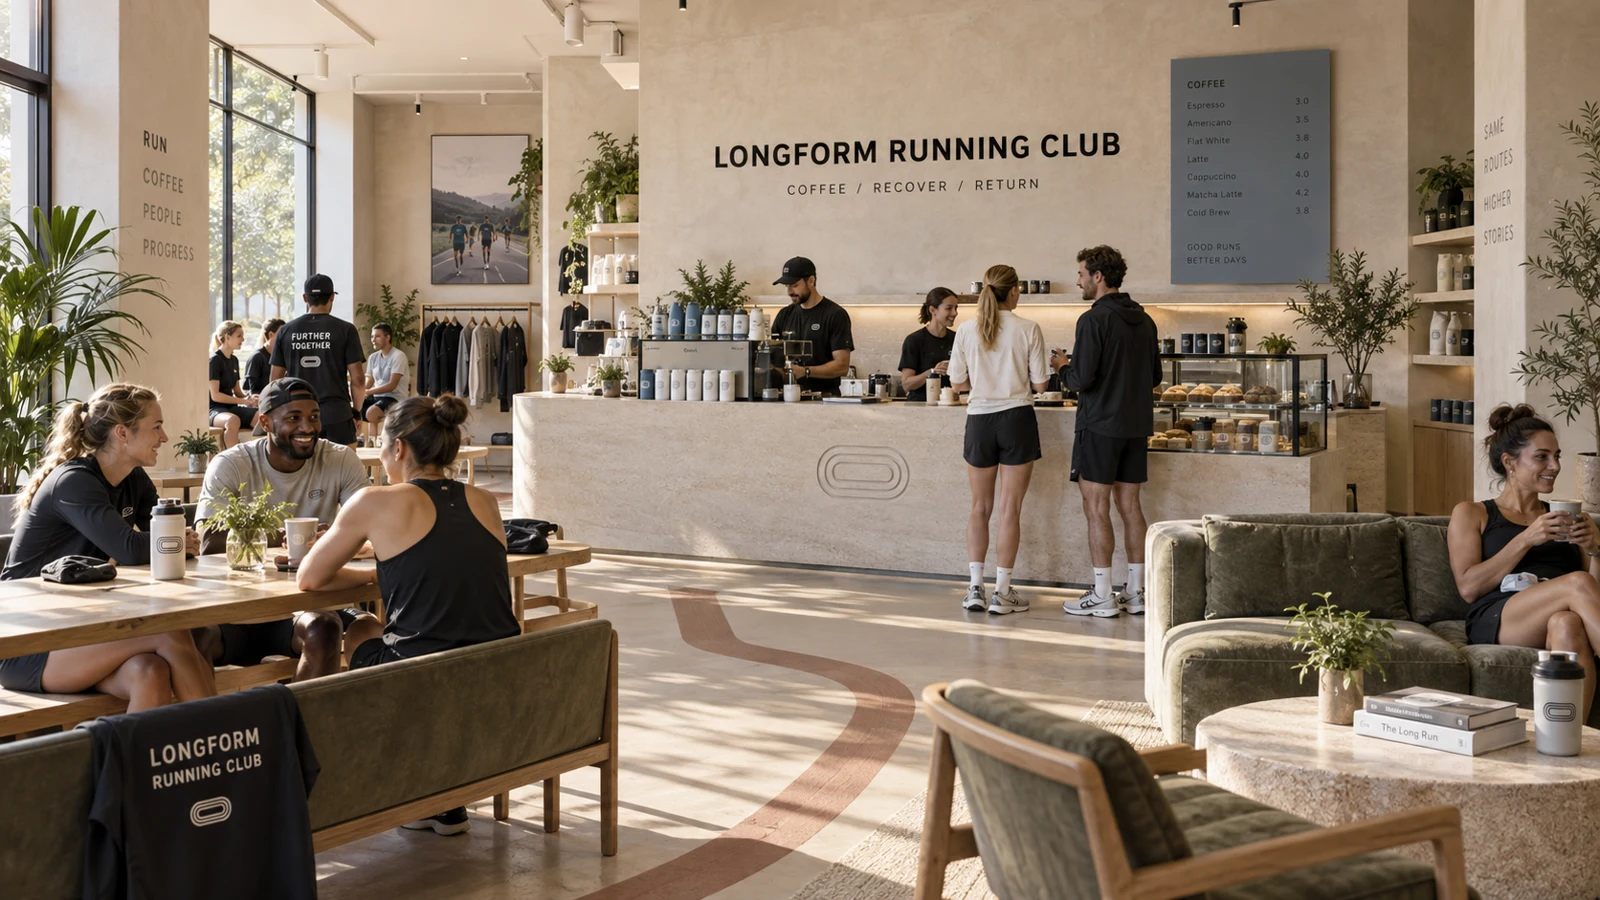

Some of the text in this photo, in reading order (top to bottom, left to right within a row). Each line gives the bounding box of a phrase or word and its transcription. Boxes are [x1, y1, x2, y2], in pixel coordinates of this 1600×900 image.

[1187, 79, 1226, 89] COFFEE
[1187, 97, 1310, 111] Espresso 3.0
[1187, 115, 1310, 128] Americano 3.5
[1484, 116, 1504, 140] SAME
[143, 130, 168, 154] RUN
[1187, 133, 1310, 145] Flat White 3.8
[714, 132, 1121, 168] LONGFORM RUNNING CLUB
[1187, 151, 1310, 164] Latte 4.0
[1484, 148, 1514, 174] ROUTES
[143, 167, 184, 194] COFFEE
[1187, 170, 1310, 182] Cappuccino 4.0
[787, 183, 847, 195] COFFEE
[873, 180, 948, 193] RECOVER
[975, 178, 1039, 191] RETURN
[1187, 188, 1310, 199] Matcha Latte 4.2
[1484, 189, 1512, 212] HIGHER
[143, 202, 182, 227] PEOPLE
[1187, 206, 1310, 217] Cold Brew 3.8
[1484, 224, 1515, 246] STORIES
[143, 238, 195, 262] PROGRESS
[1187, 243, 1241, 251] GOOD RUNS
[1187, 256, 1247, 264] BETTER DAYS
[291, 332, 331, 341] FURTHER
[291, 341, 331, 350] TOGETHER
[1381, 723, 1397, 734] The
[1399, 725, 1419, 740] Long
[1421, 731, 1439, 742] Run
[149, 727, 260, 767] LONGFORM
[152, 753, 262, 790] RUNNING CLUB
